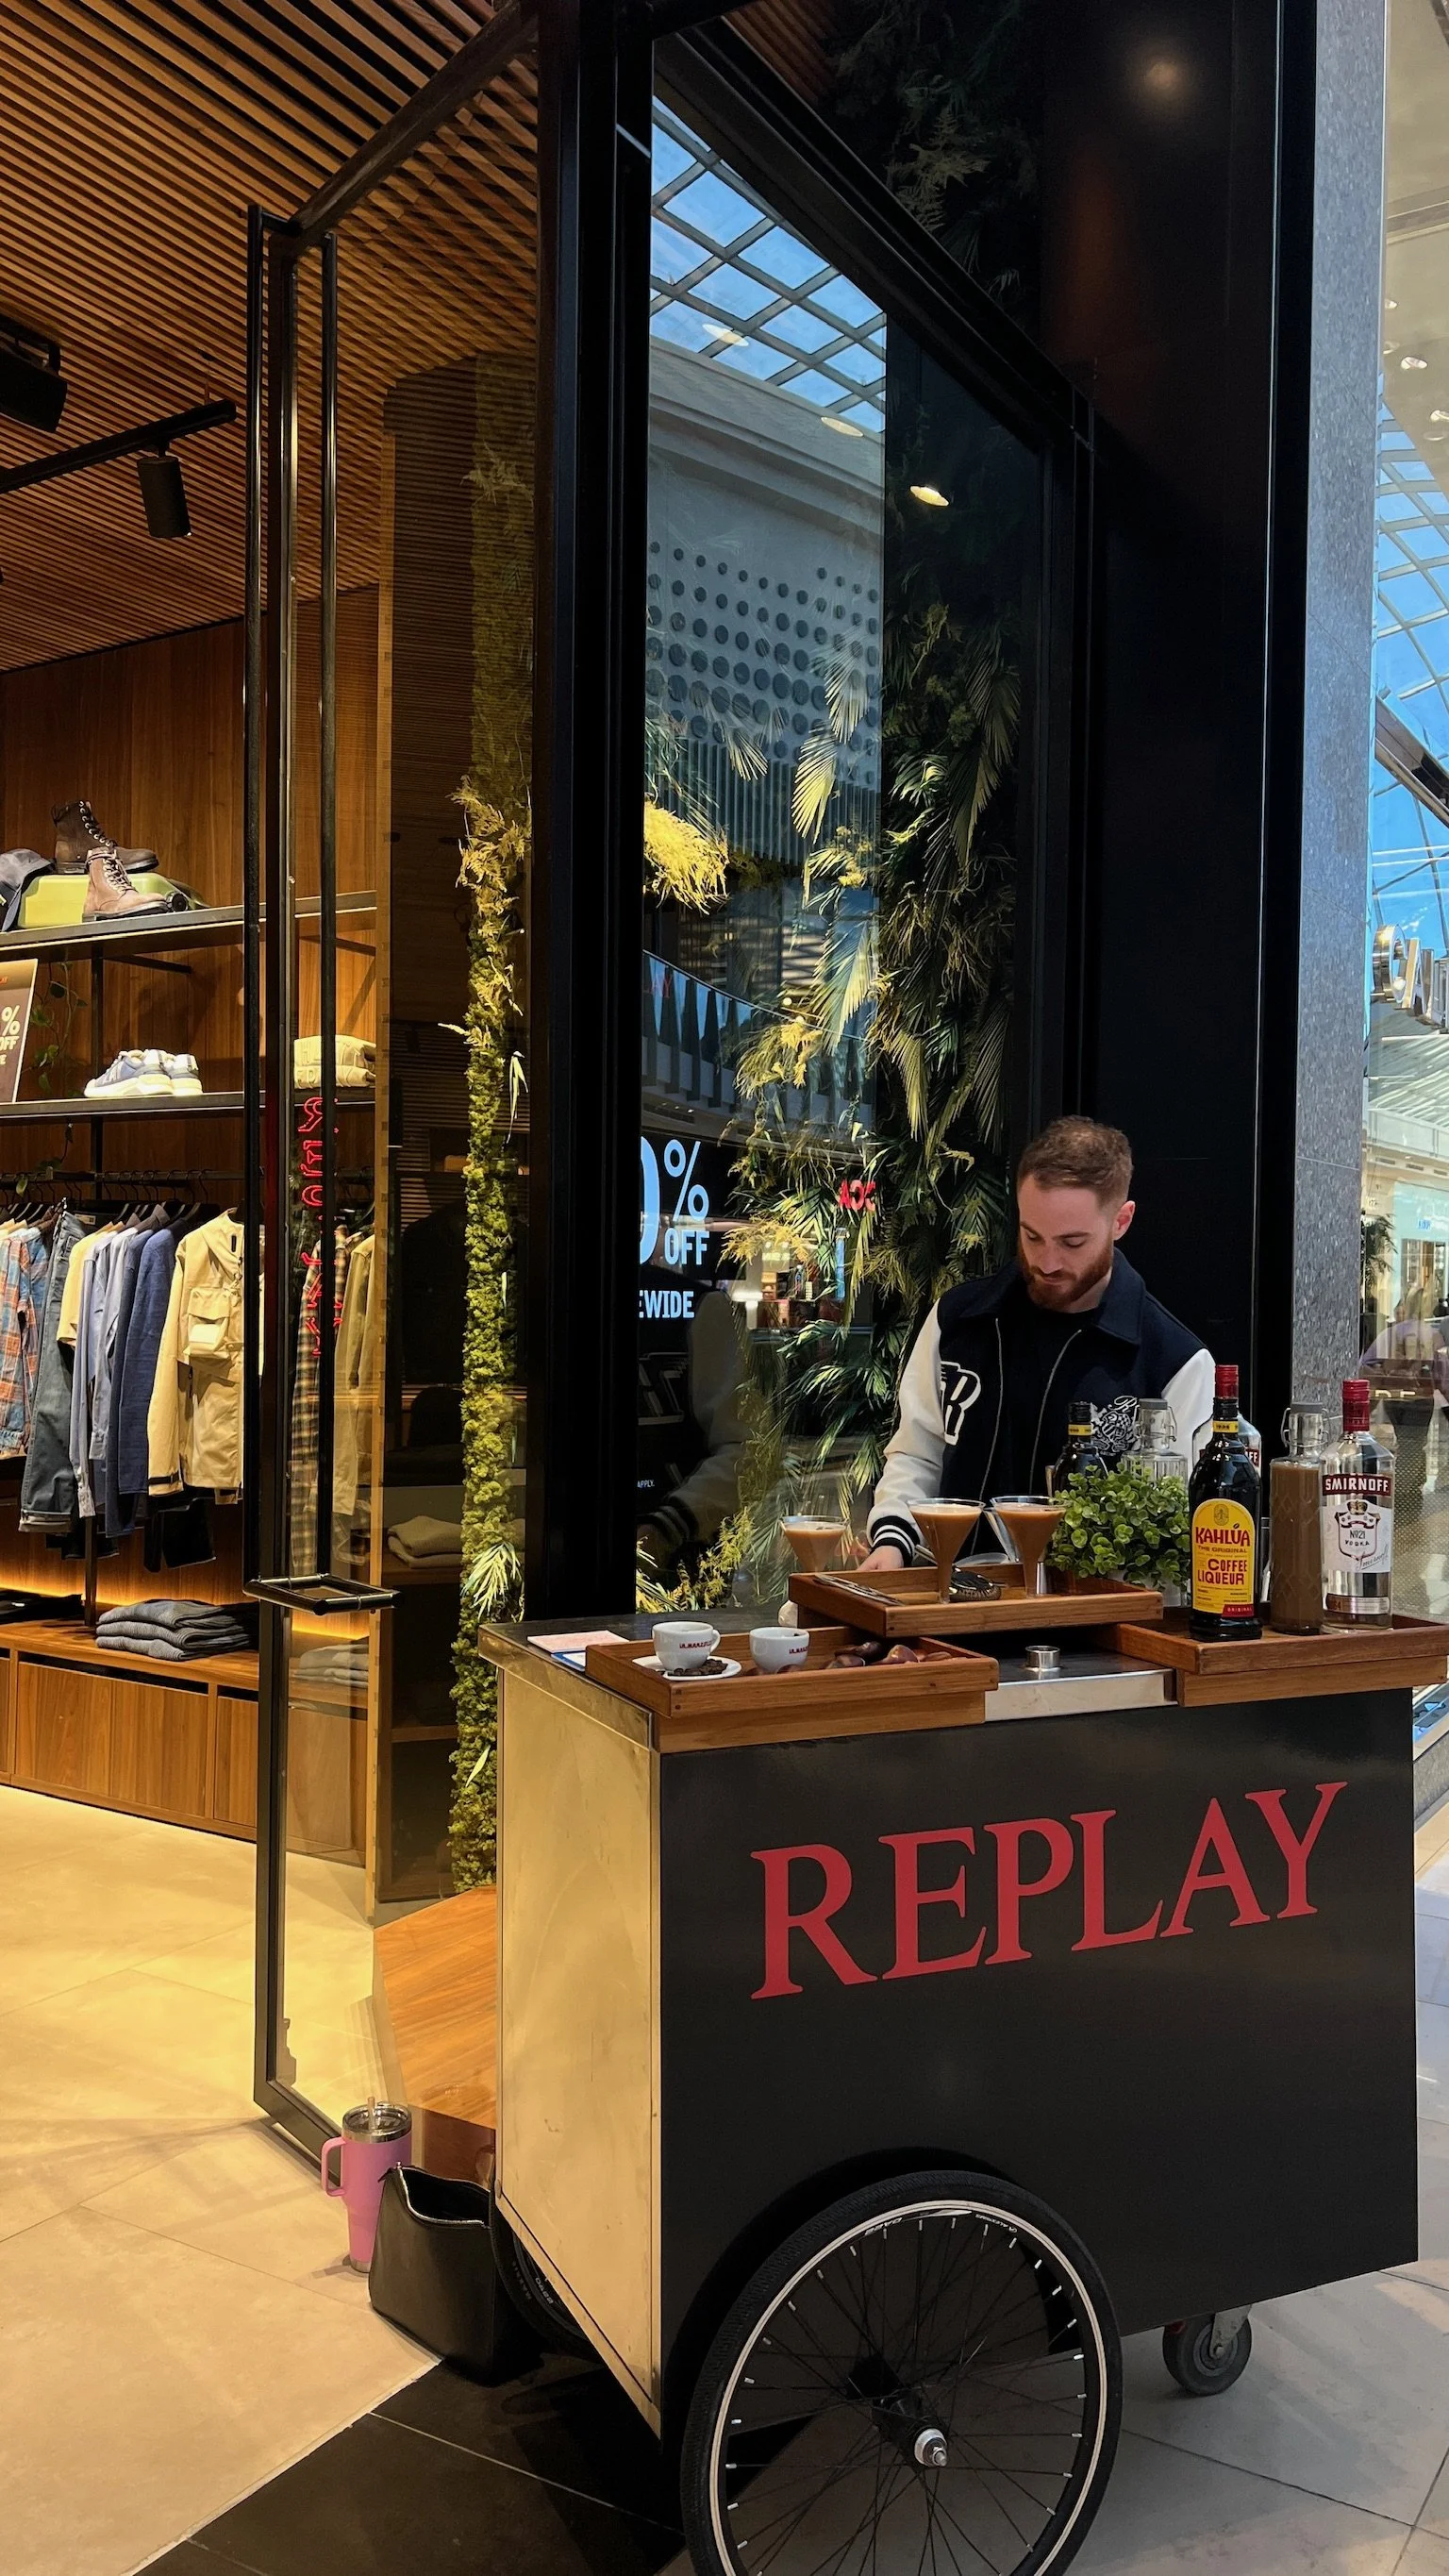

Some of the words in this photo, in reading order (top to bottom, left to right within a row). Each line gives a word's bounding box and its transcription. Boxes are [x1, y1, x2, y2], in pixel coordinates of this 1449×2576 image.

[664, 1227, 709, 1265] OFF
[1324, 1476, 1390, 1493] SMIRNOFF
[1195, 1523, 1251, 1547] KAHLÚA
[1208, 1558, 1248, 1573] COFFEE
[1197, 1569, 1245, 1585] LIQUEUR
[750, 1781, 1348, 1999] REPLAY
